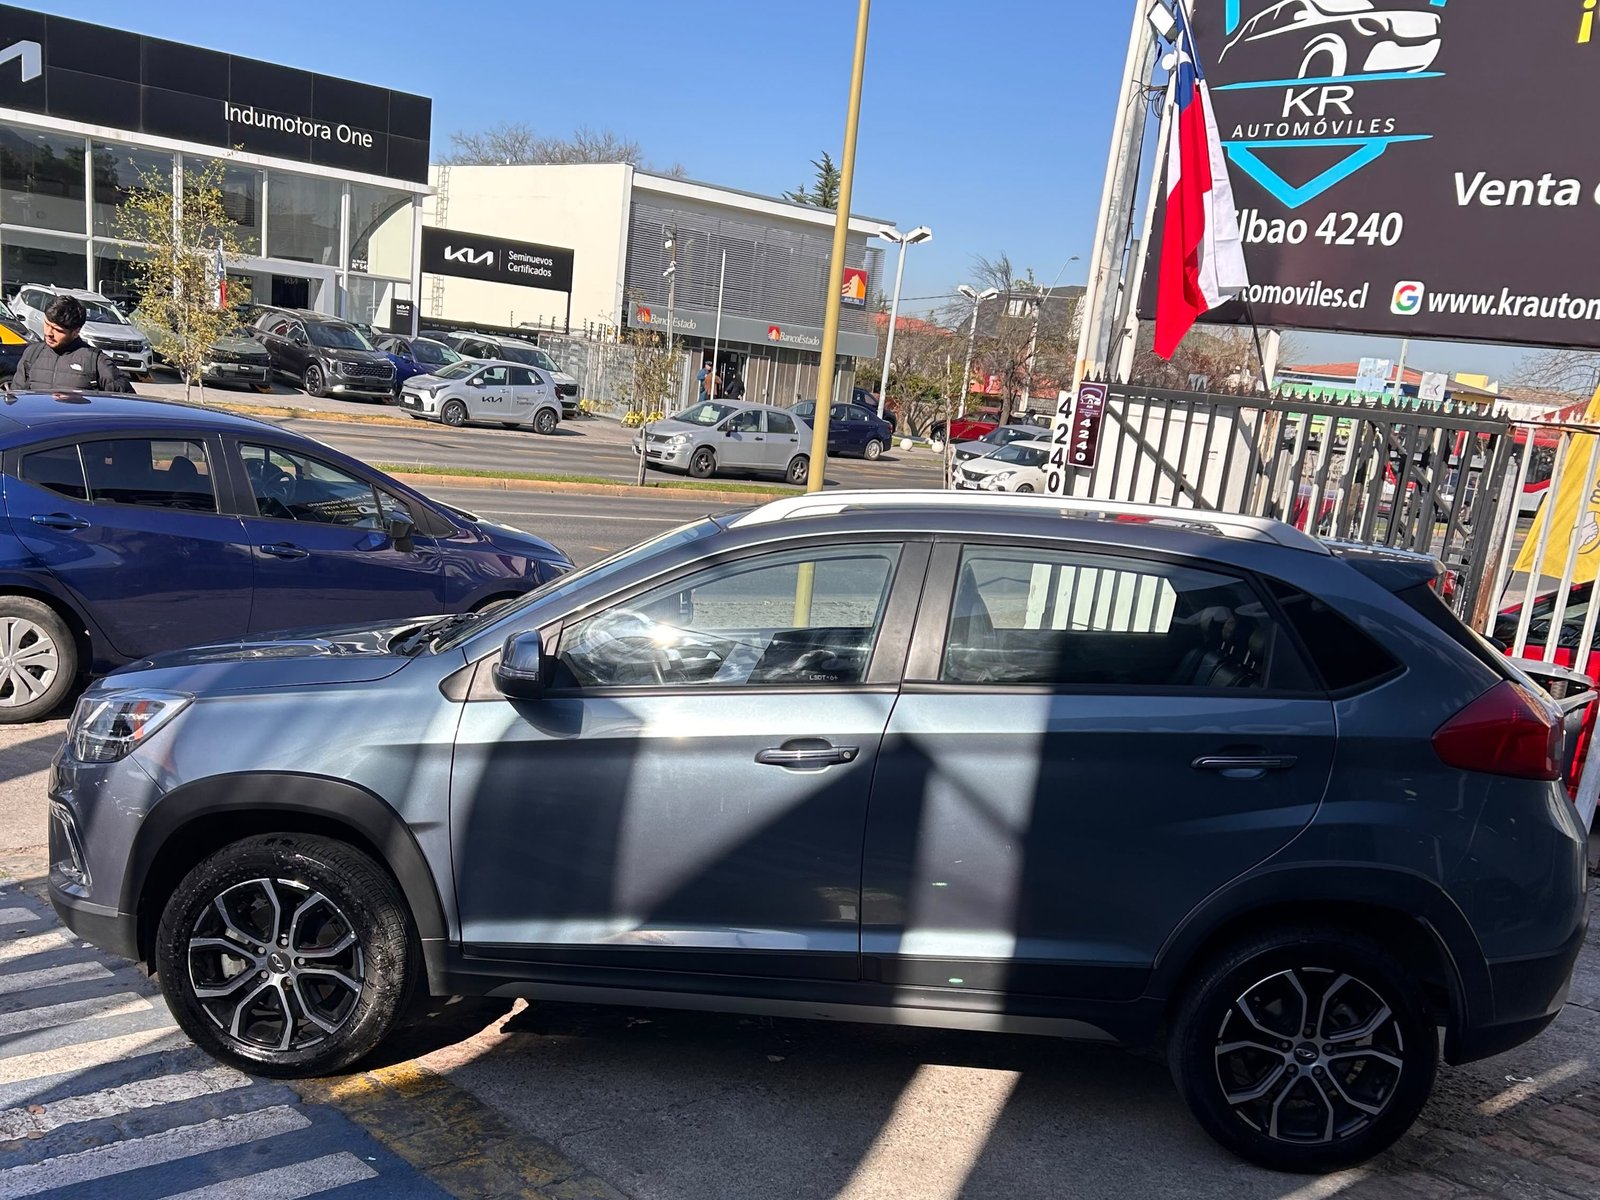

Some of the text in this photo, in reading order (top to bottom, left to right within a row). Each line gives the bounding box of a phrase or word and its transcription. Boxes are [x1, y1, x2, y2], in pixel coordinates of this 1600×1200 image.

[1282, 85, 1355, 118] KR
[224, 101, 373, 148] Indumotora One
[1231, 118, 1396, 139] AUTOMÓVILES
[1454, 172, 1581, 206] Venta
[1235, 209, 1403, 246] lbao 4240
[507, 262, 552, 277] Certificados
[508, 250, 553, 266] Seminuevos
[1241, 280, 1369, 309] tomoviles.cl
[650, 313, 697, 330] BancEstado
[780, 331, 820, 346] BancoEstado
[1048, 397, 1073, 493] 4240
[1075, 418, 1092, 462] 4240
